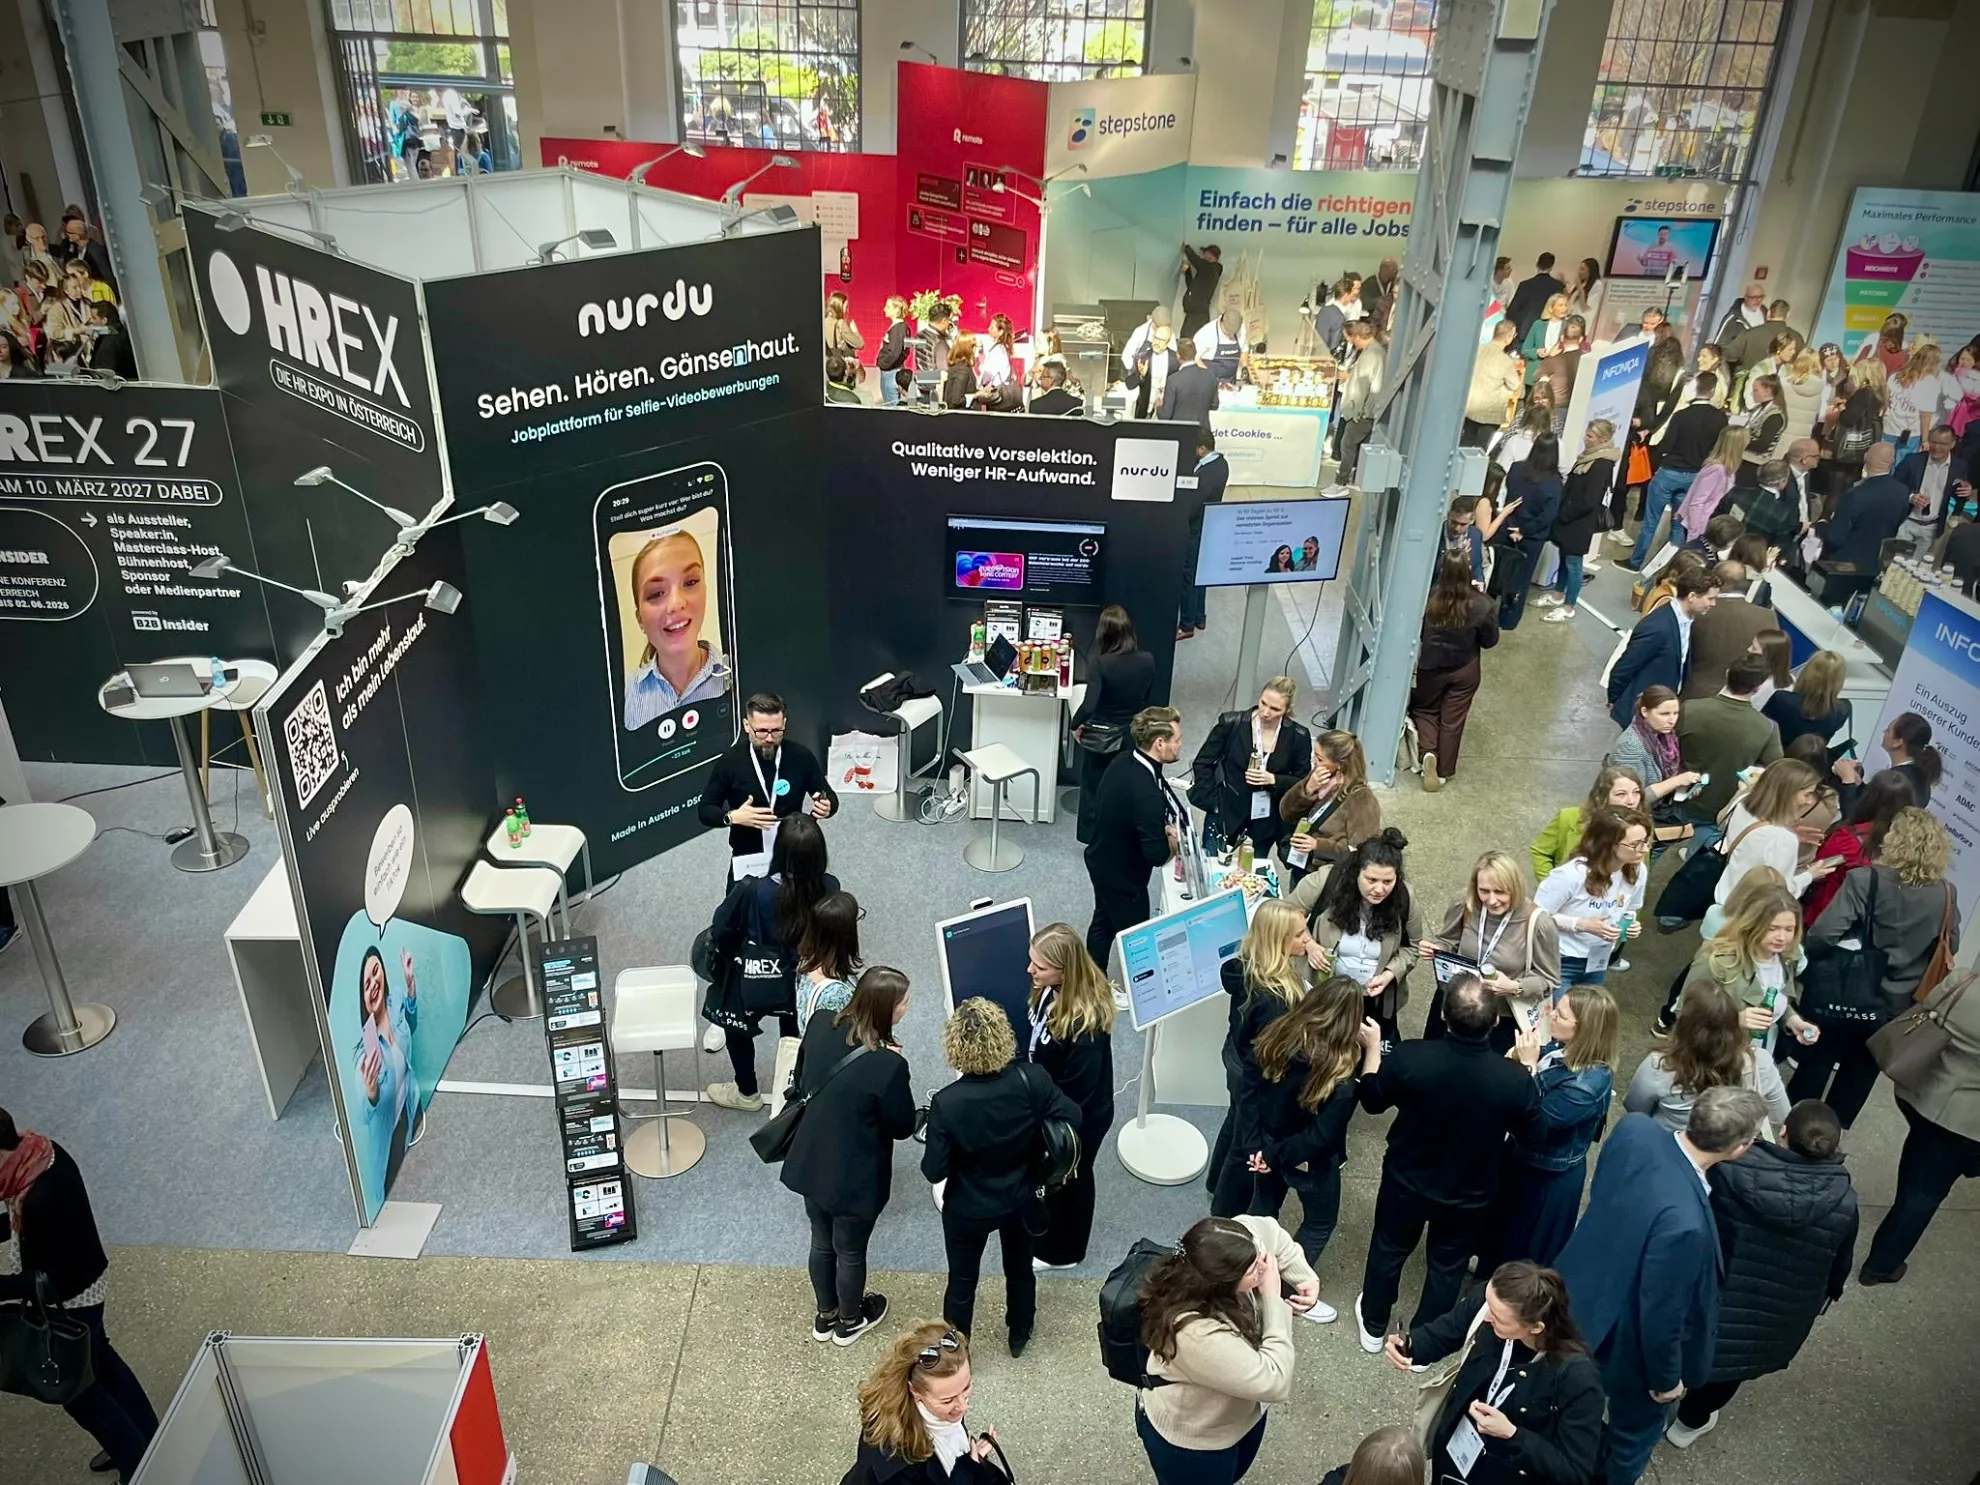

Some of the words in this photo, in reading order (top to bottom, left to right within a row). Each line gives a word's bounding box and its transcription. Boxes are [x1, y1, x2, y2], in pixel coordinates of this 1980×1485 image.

[1099, 110, 1176, 137] stepstone
[1200, 189, 1276, 211] Einfach
[1281, 193, 1313, 212] die
[1317, 195, 1411, 218] richtigen
[1644, 199, 1715, 214] stepstone
[1197, 213, 1263, 232] finden
[1287, 215, 1318, 235] für
[1321, 217, 1358, 235] alle
[1862, 209, 1913, 221] Maximales
[1914, 212, 1977, 225] Performance
[578, 279, 713, 337] nurdu
[256, 263, 411, 408] HREX
[477, 382, 569, 420] Sehen.
[575, 363, 655, 400] Hören.
[275, 367, 292, 389] DIE
[293, 375, 307, 395] HR
[308, 381, 335, 407] EXPO
[337, 396, 349, 413] IN
[350, 397, 416, 445] ÖSTERREICH
[510, 408, 601, 445] Jobplattform
[604, 405, 623, 425] für
[625, 373, 780, 420] Selfie-Videobewerbungen
[126, 417, 196, 468] 27
[1231, 428, 1272, 439] Cookies
[891, 440, 984, 461] Qualitative
[988, 446, 1098, 466] Vorselektion.
[911, 462, 981, 482] Weniger
[985, 466, 1096, 486] HR-Aufwand.
[1120, 466, 1169, 477] nurdu
[26, 480, 52, 495] 10.
[56, 479, 108, 498] MÄRZ
[111, 483, 152, 498] 2027
[157, 484, 210, 501] DABEI
[107, 512, 125, 524] als
[128, 513, 192, 529] Aussteller,
[624, 510, 637, 519] dich
[110, 527, 178, 542] Speaker:in,
[114, 542, 224, 557] Masterclass-Host,
[117, 555, 192, 571] Bühnenhost,
[11, 577, 67, 587] KONFERENZ
[121, 570, 170, 584] Sponsor
[125, 584, 152, 596] oder
[155, 585, 241, 599] Medienpartner
[15, 600, 70, 610] 02.06.2026
[137, 619, 158, 628] B2B
[162, 619, 210, 631] Insider
[336, 674, 353, 703] Ich
[352, 656, 368, 684] bin
[368, 625, 390, 667] mehr
[342, 703, 358, 729] als
[357, 678, 382, 711] mein
[380, 612, 427, 678] Lebenslauf.
[1909, 699, 1949, 728] unserer
[1914, 682, 1931, 701] Ein
[1930, 692, 1967, 725] Auszug
[306, 818, 321, 842] Live
[320, 767, 359, 826] ausprobieren
[1956, 795, 1976, 812] ADAC
[611, 824, 636, 842] Made
[638, 819, 647, 829] in
[648, 805, 680, 825] Austria
[744, 958, 782, 974] HREX
